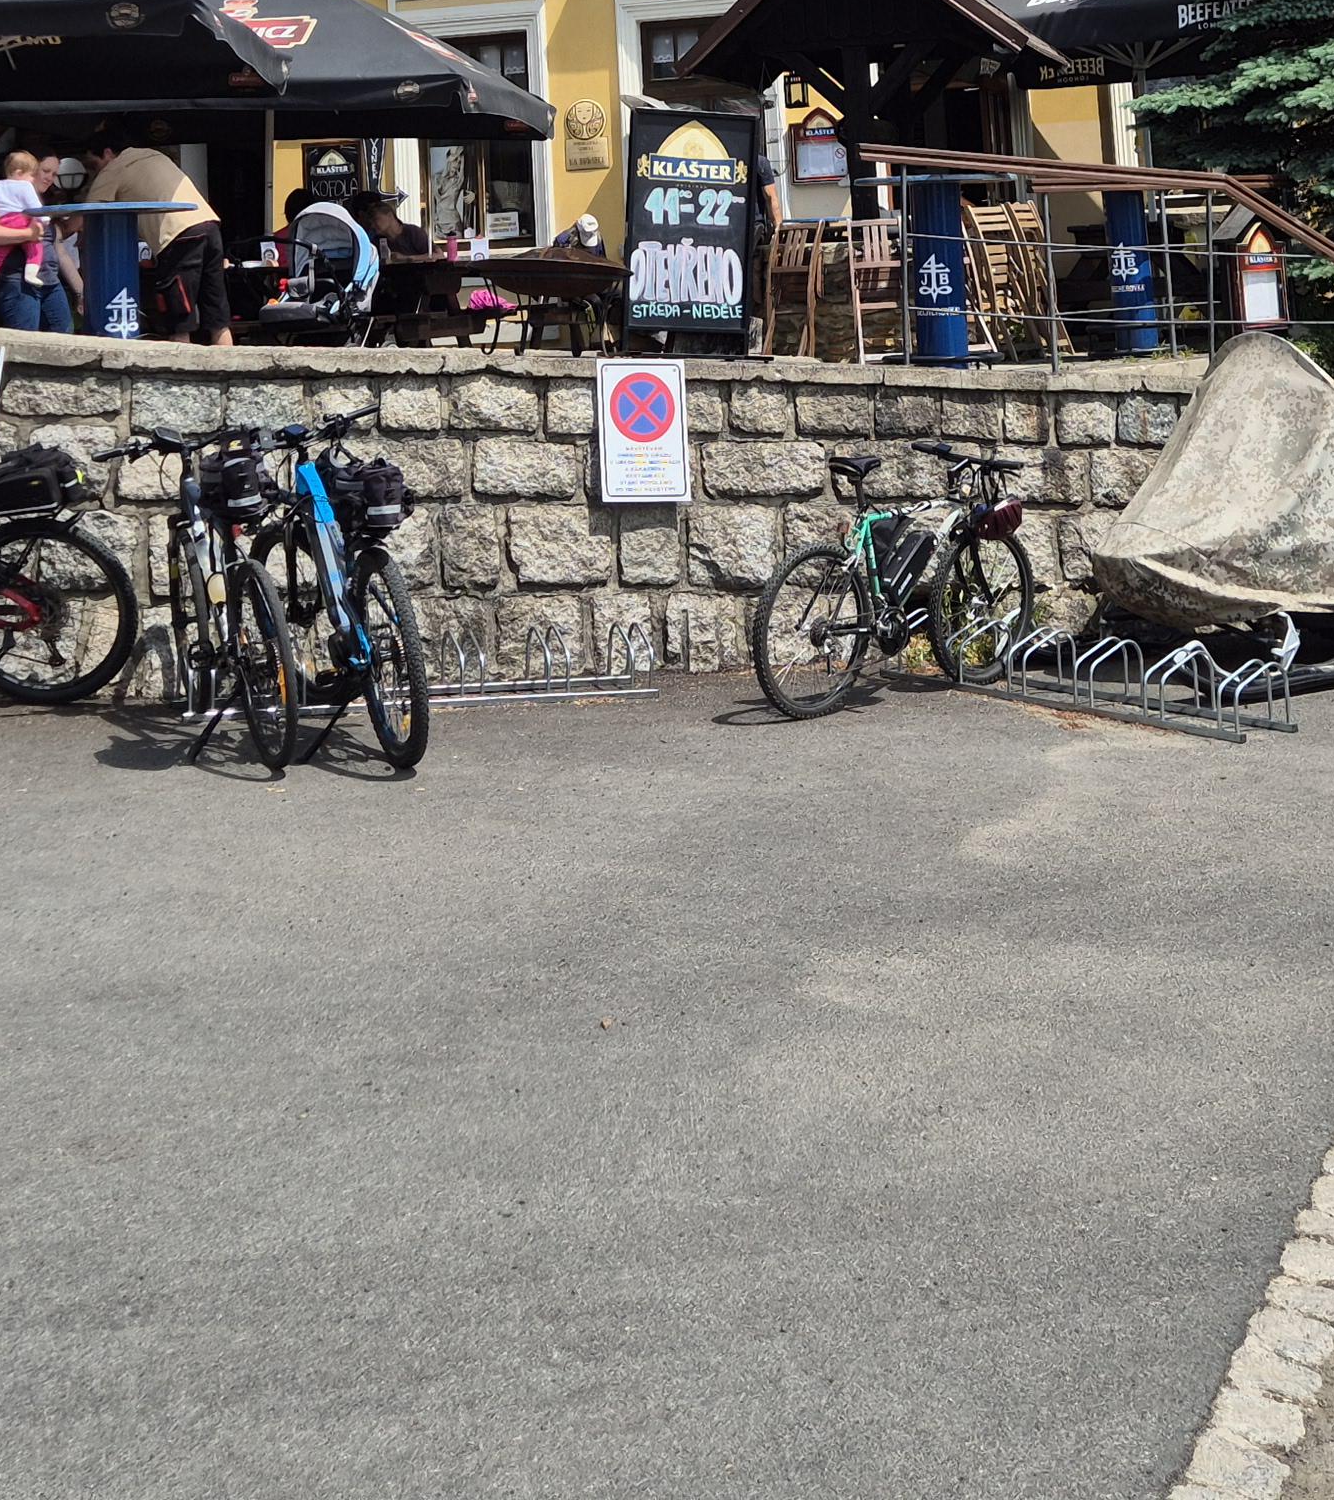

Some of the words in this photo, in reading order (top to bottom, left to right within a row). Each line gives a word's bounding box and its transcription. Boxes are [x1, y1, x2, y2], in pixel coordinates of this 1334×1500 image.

[652, 160, 732, 181] KLÁŠTER
[311, 178, 359, 198] KOFOLA
[630, 237, 744, 305] OTEVŘENO
[632, 301, 680, 319] STŘEDA
[692, 304, 743, 319] NEDĚLE
